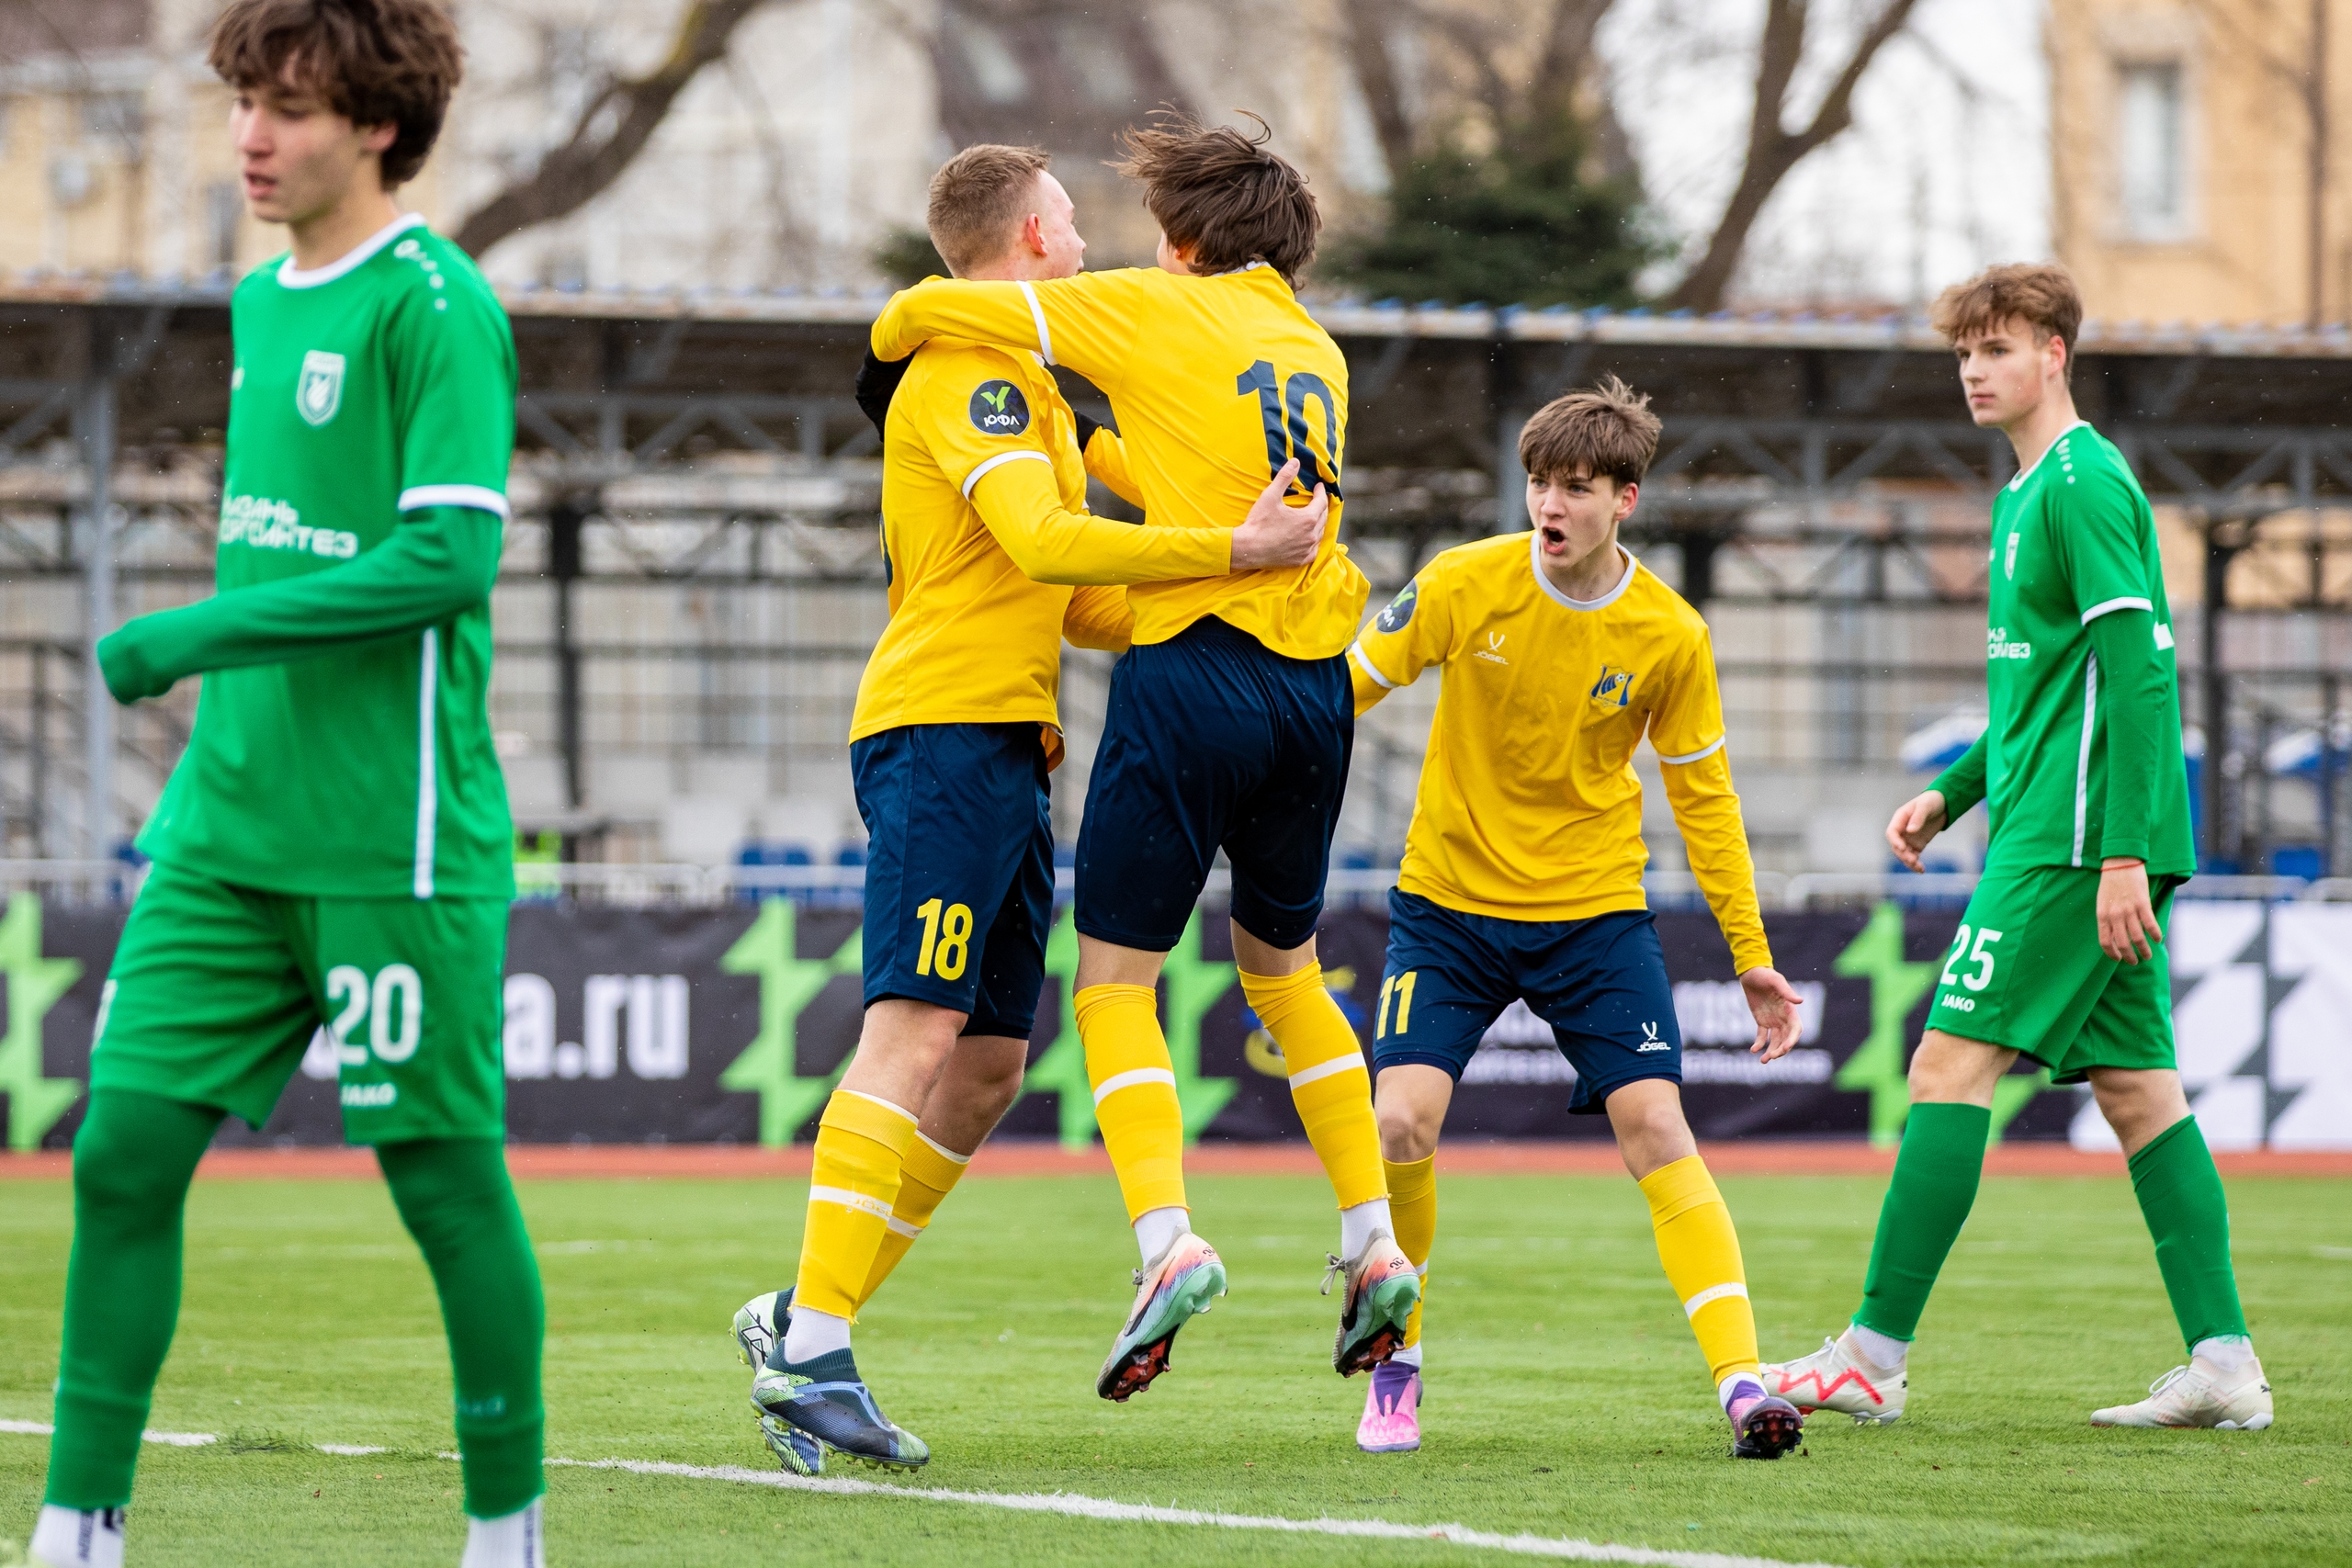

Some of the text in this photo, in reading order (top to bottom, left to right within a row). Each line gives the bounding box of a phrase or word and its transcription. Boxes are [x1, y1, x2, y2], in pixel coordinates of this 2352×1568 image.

[983, 414, 1020, 427] ЮФЛ
[1236, 359, 1344, 502] 10
[916, 897, 973, 981] 18
[1940, 923, 2004, 992] 25
[326, 963, 423, 1066] 20
[1376, 971, 1418, 1041] 11
[1940, 993, 1975, 1012] JAKO
